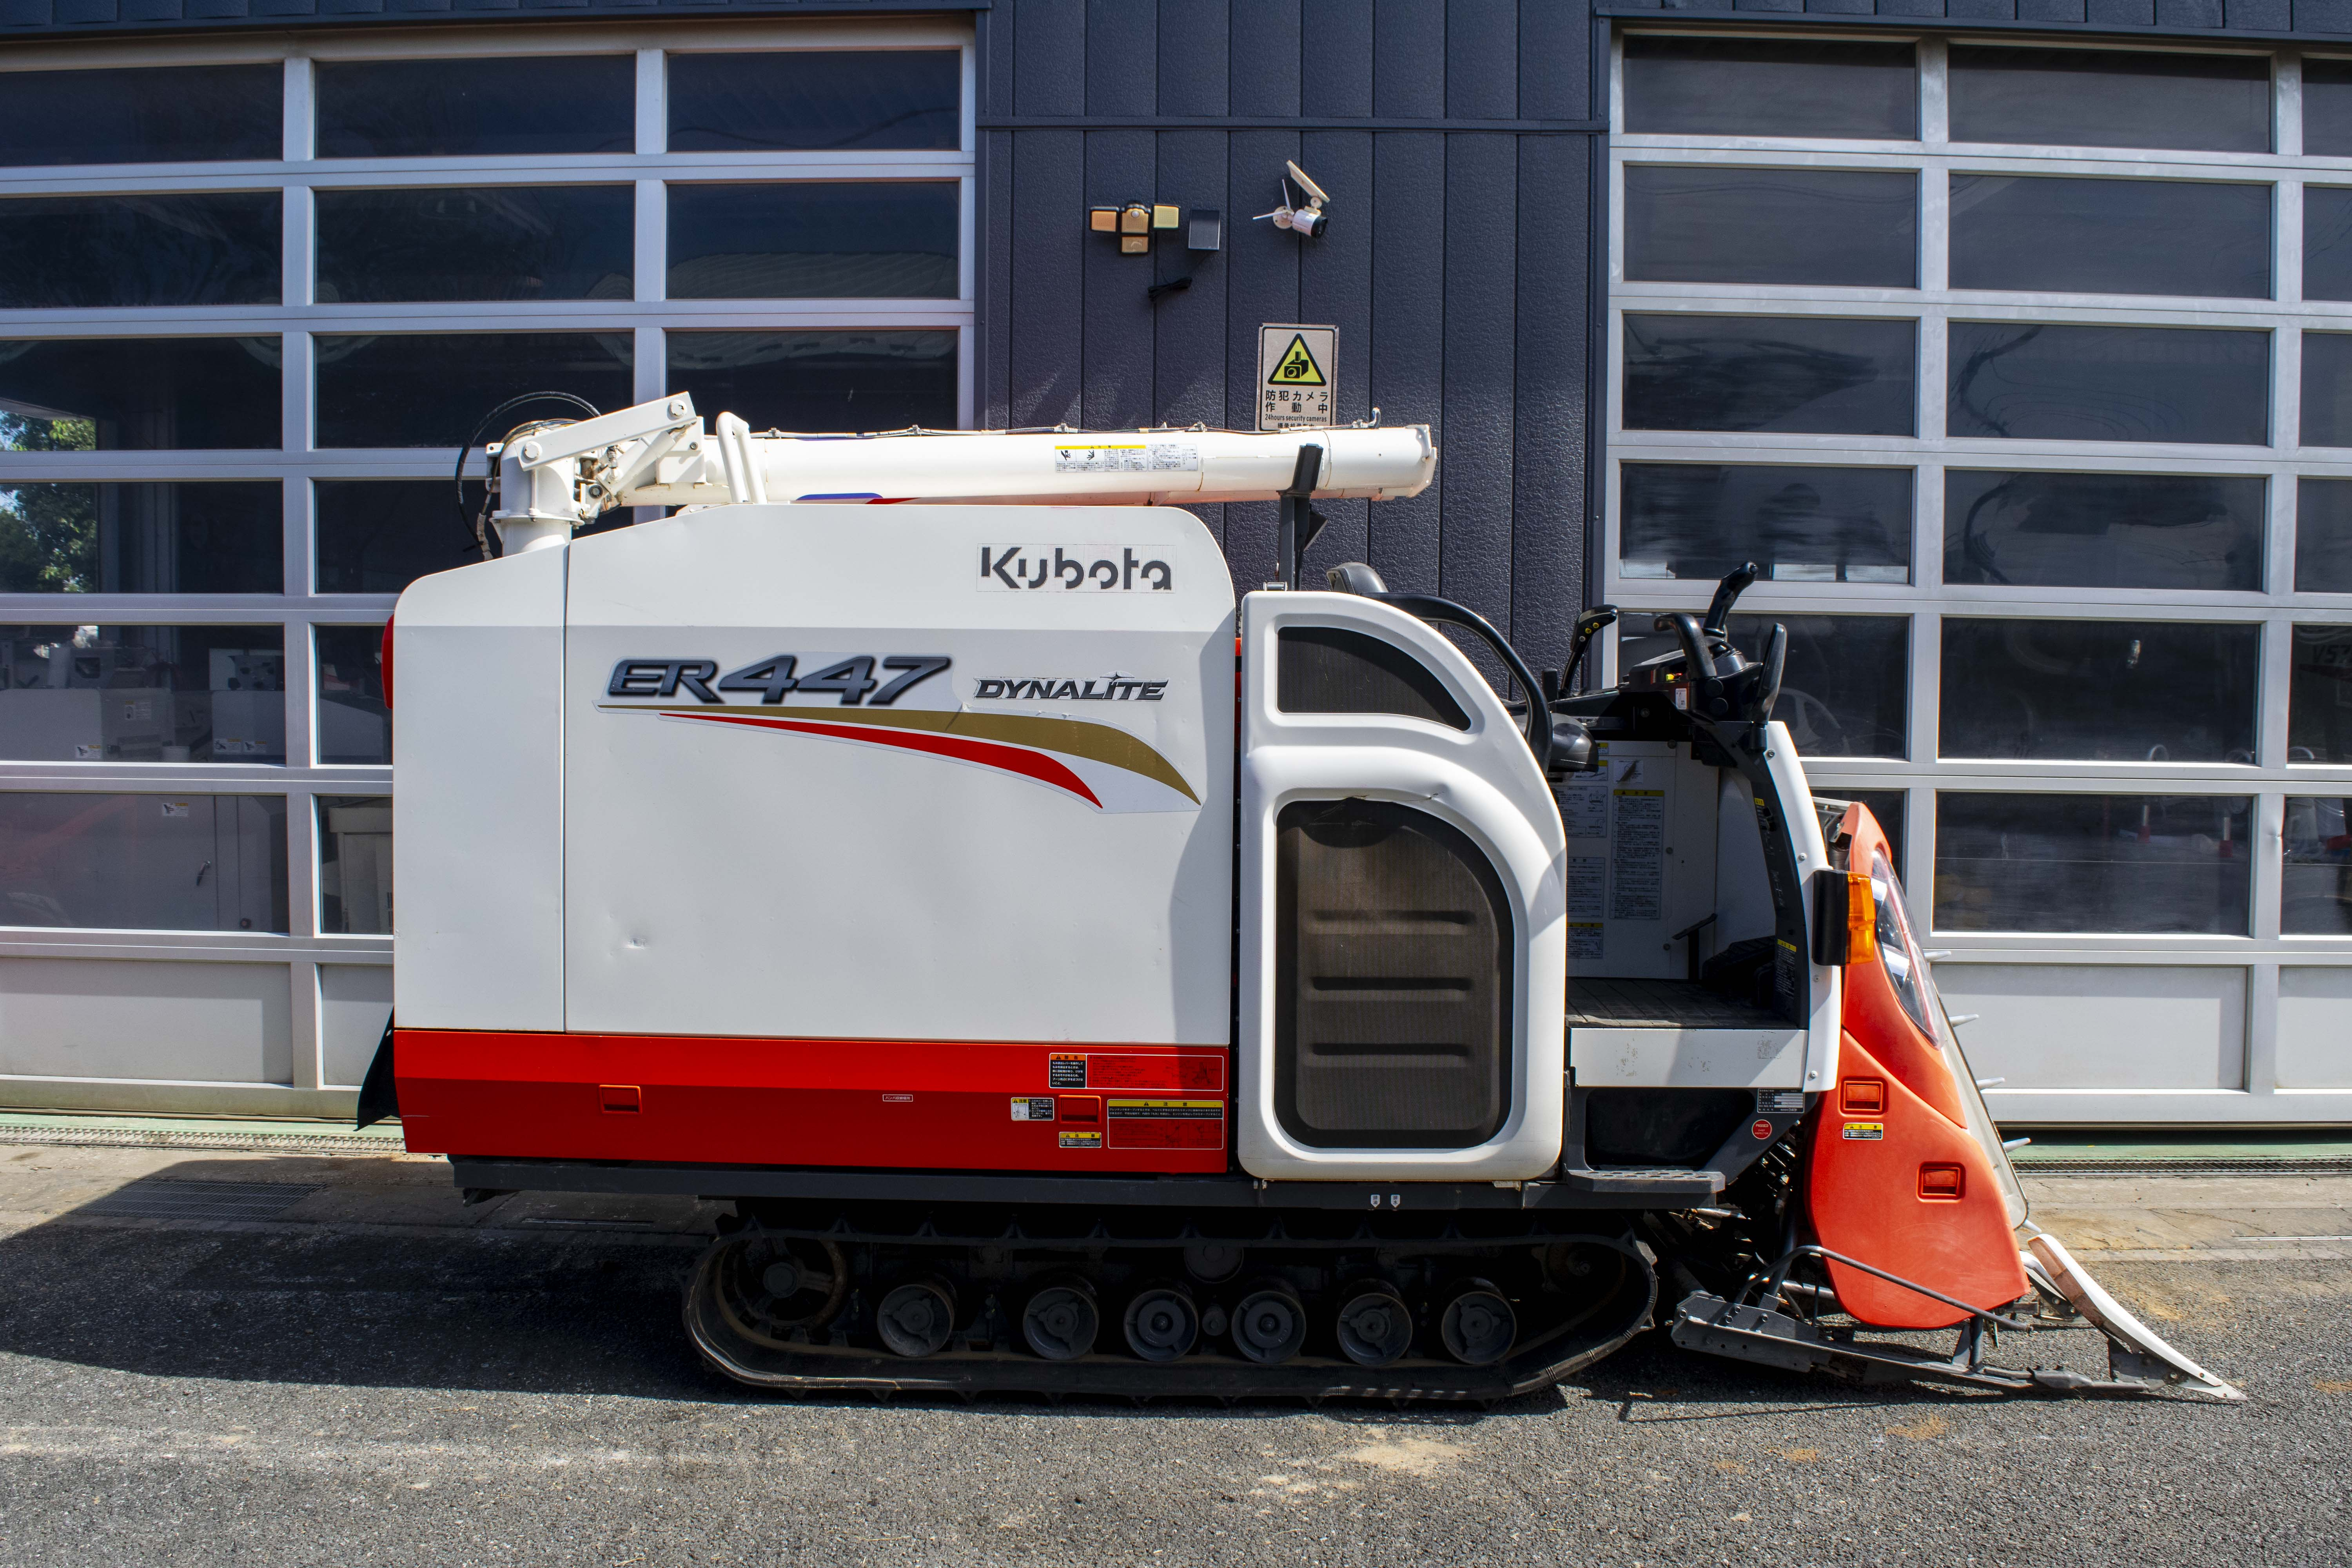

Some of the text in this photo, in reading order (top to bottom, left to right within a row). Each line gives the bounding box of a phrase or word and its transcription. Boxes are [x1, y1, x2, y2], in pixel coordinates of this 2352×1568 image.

[1266, 390, 1328, 401] 防犯カメラ
[1265, 402, 1327, 414] 作動中
[981, 547, 1172, 590] Kubota
[979, 678, 1169, 701] DYNALITE
